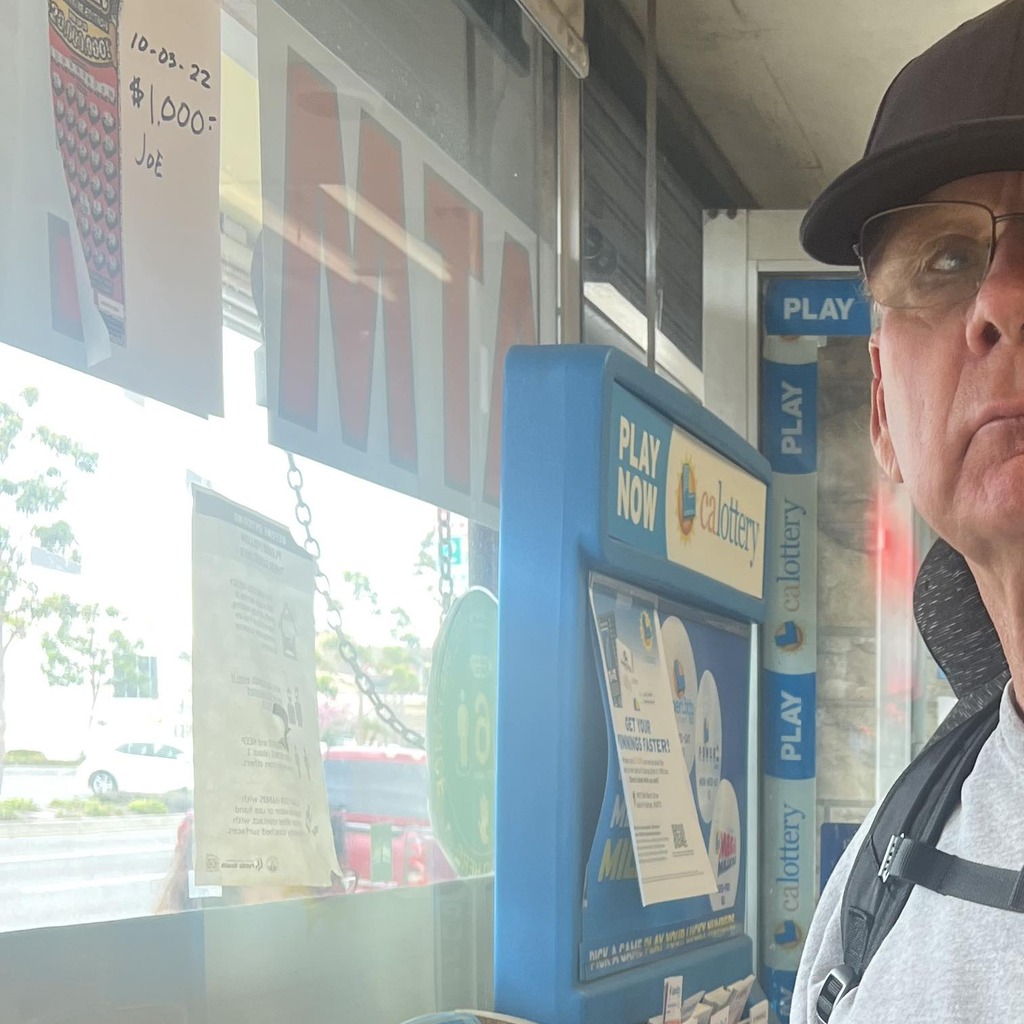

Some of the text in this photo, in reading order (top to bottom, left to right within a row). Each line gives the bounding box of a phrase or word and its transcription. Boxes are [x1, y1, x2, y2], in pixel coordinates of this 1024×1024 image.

[784, 297, 855, 321] PLAY
[619, 415, 661, 479] PLAY
[781, 381, 804, 455] PLAY
[617, 466, 658, 532] NOW
[700, 480, 760, 568] calottery
[776, 499, 806, 612] calottery
[625, 716, 652, 735] GET YOUR
[643, 737, 671, 753] FASTER!
[780, 689, 803, 762] PLAY
[775, 802, 807, 913] calottery
